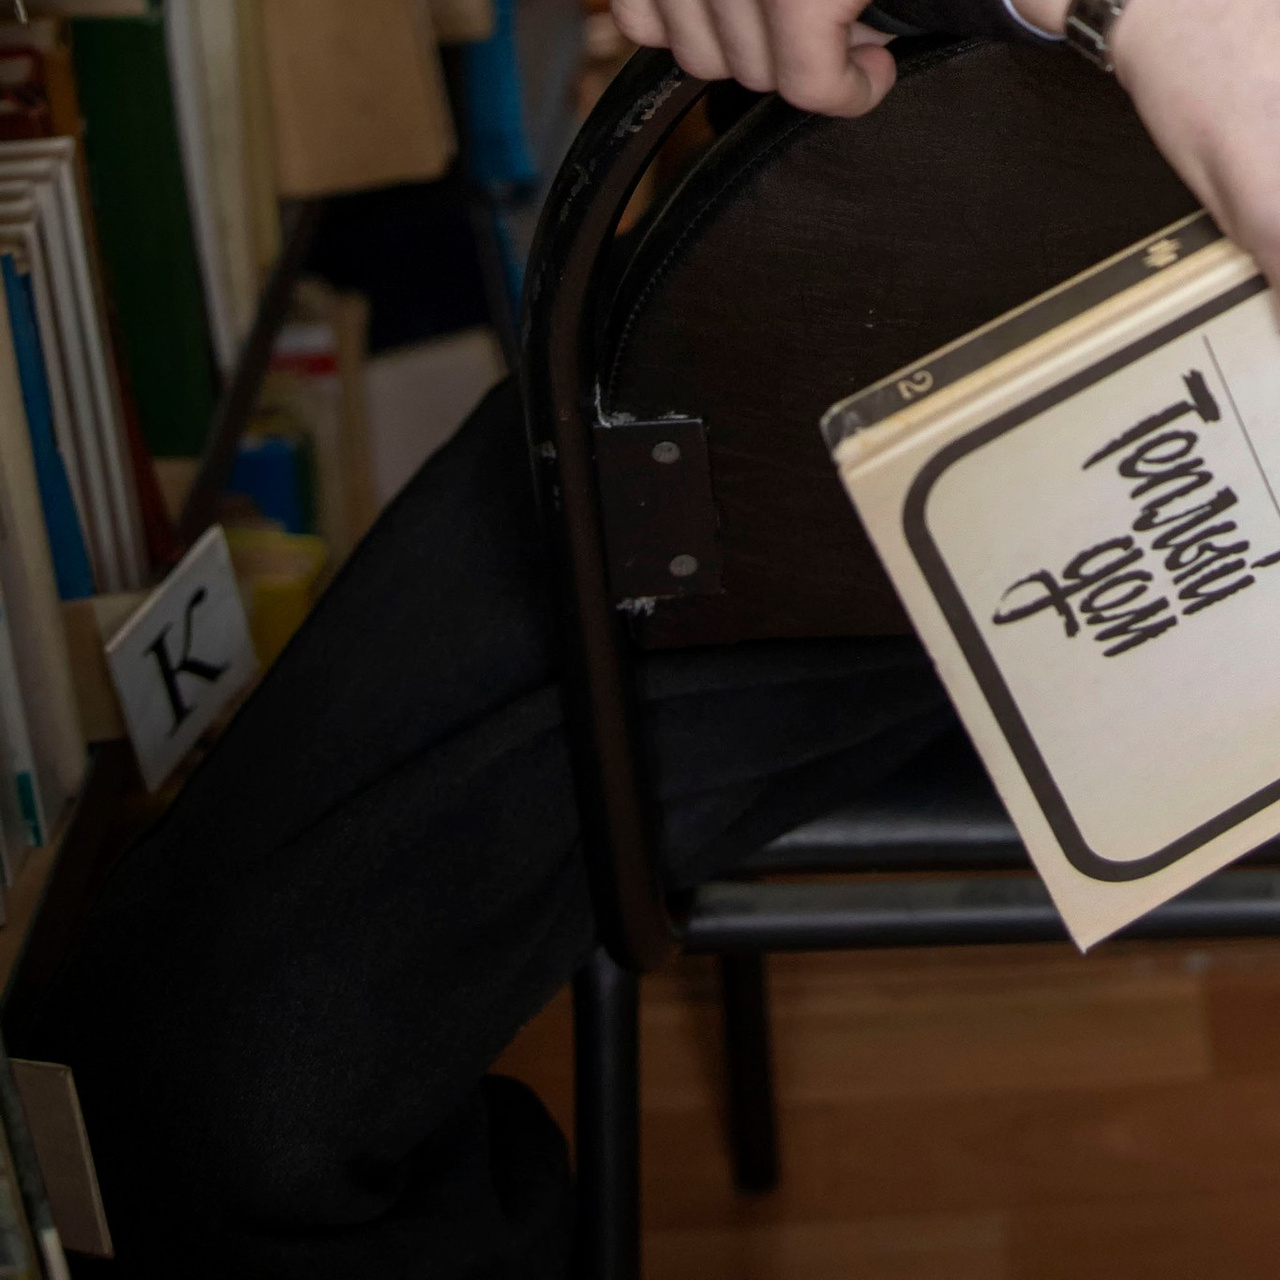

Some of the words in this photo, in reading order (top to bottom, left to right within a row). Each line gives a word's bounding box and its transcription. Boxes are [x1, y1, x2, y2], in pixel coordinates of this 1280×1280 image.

[897, 369, 934, 401] 2
[992, 534, 1178, 657] дом
[142, 585, 233, 738] К
